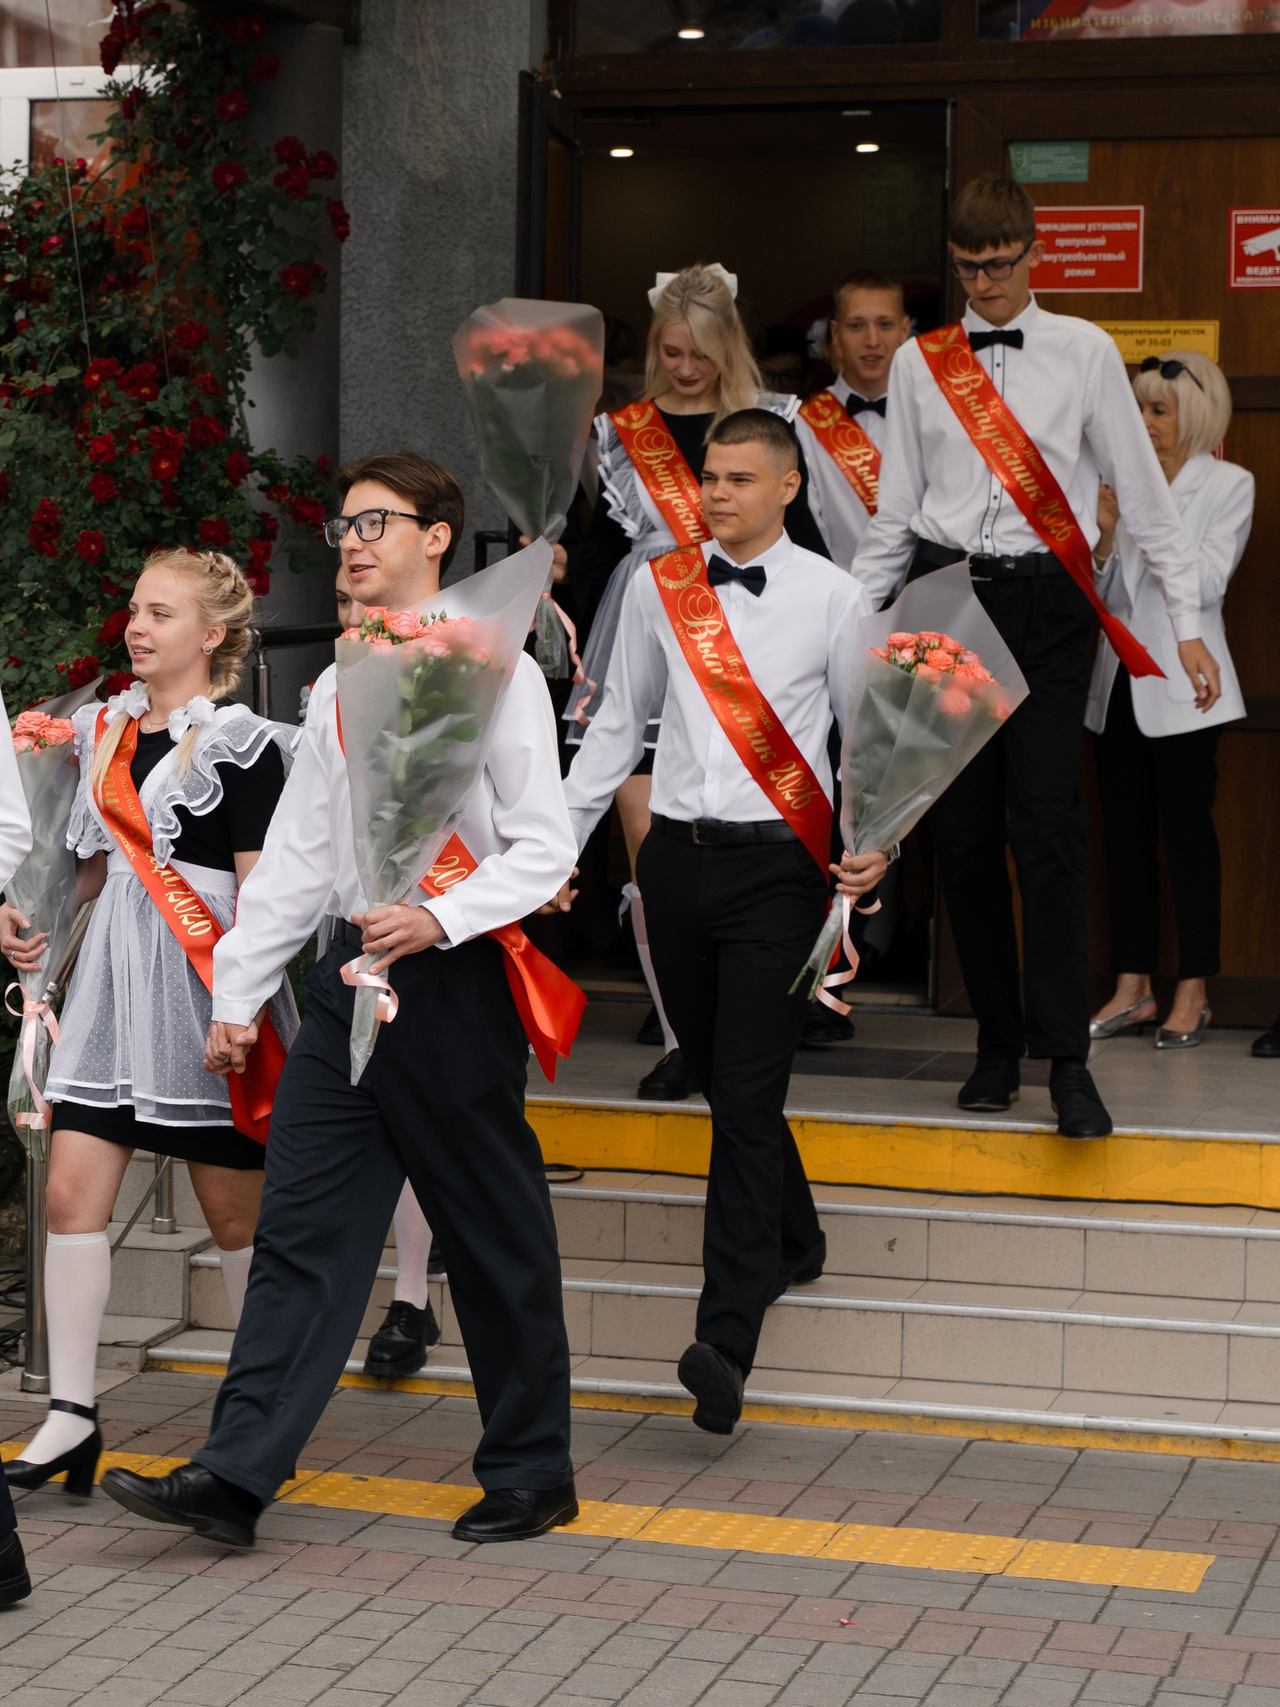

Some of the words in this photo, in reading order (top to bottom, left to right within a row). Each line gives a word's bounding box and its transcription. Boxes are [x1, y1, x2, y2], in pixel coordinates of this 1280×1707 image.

[1030, 13, 1174, 30] ИЗБИРАТЕЛЬНОГО
[940, 344, 1046, 500] Выпускник
[677, 583, 778, 765] Выпускник
[767, 760, 820, 810] 2026
[117, 760, 136, 812] Карасёва
[426, 855, 470, 895] 20
[165, 885, 214, 936] 2026
